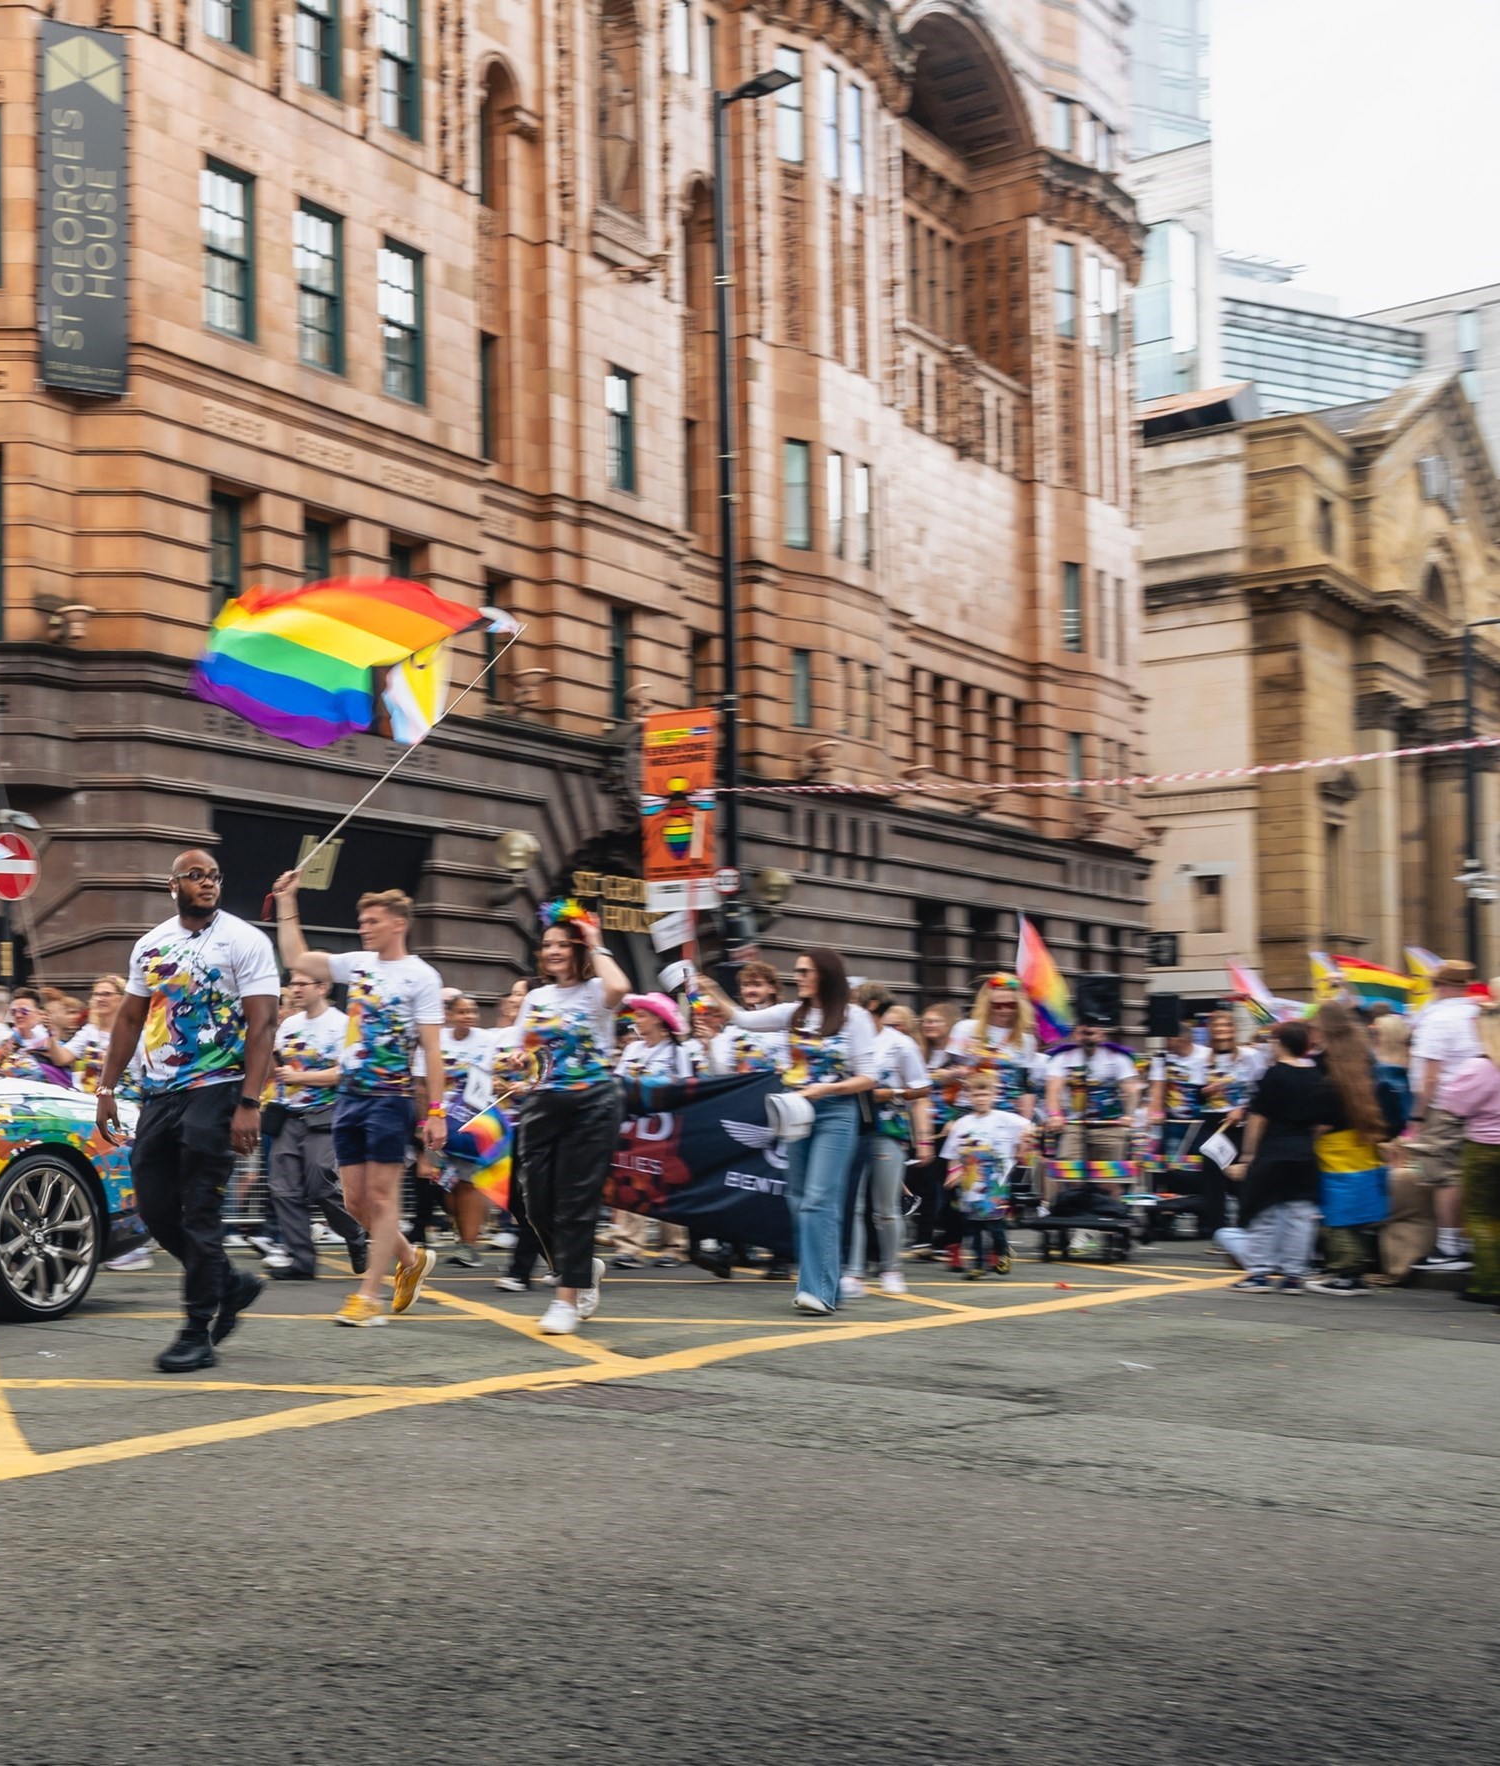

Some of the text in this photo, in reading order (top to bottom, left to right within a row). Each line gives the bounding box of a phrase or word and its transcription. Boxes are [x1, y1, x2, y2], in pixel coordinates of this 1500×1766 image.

[51, 108, 85, 297] GEORGE'S
[83, 168, 117, 299] HOUSE
[51, 305, 85, 350] ST
[724, 1171, 790, 1196] BENT
